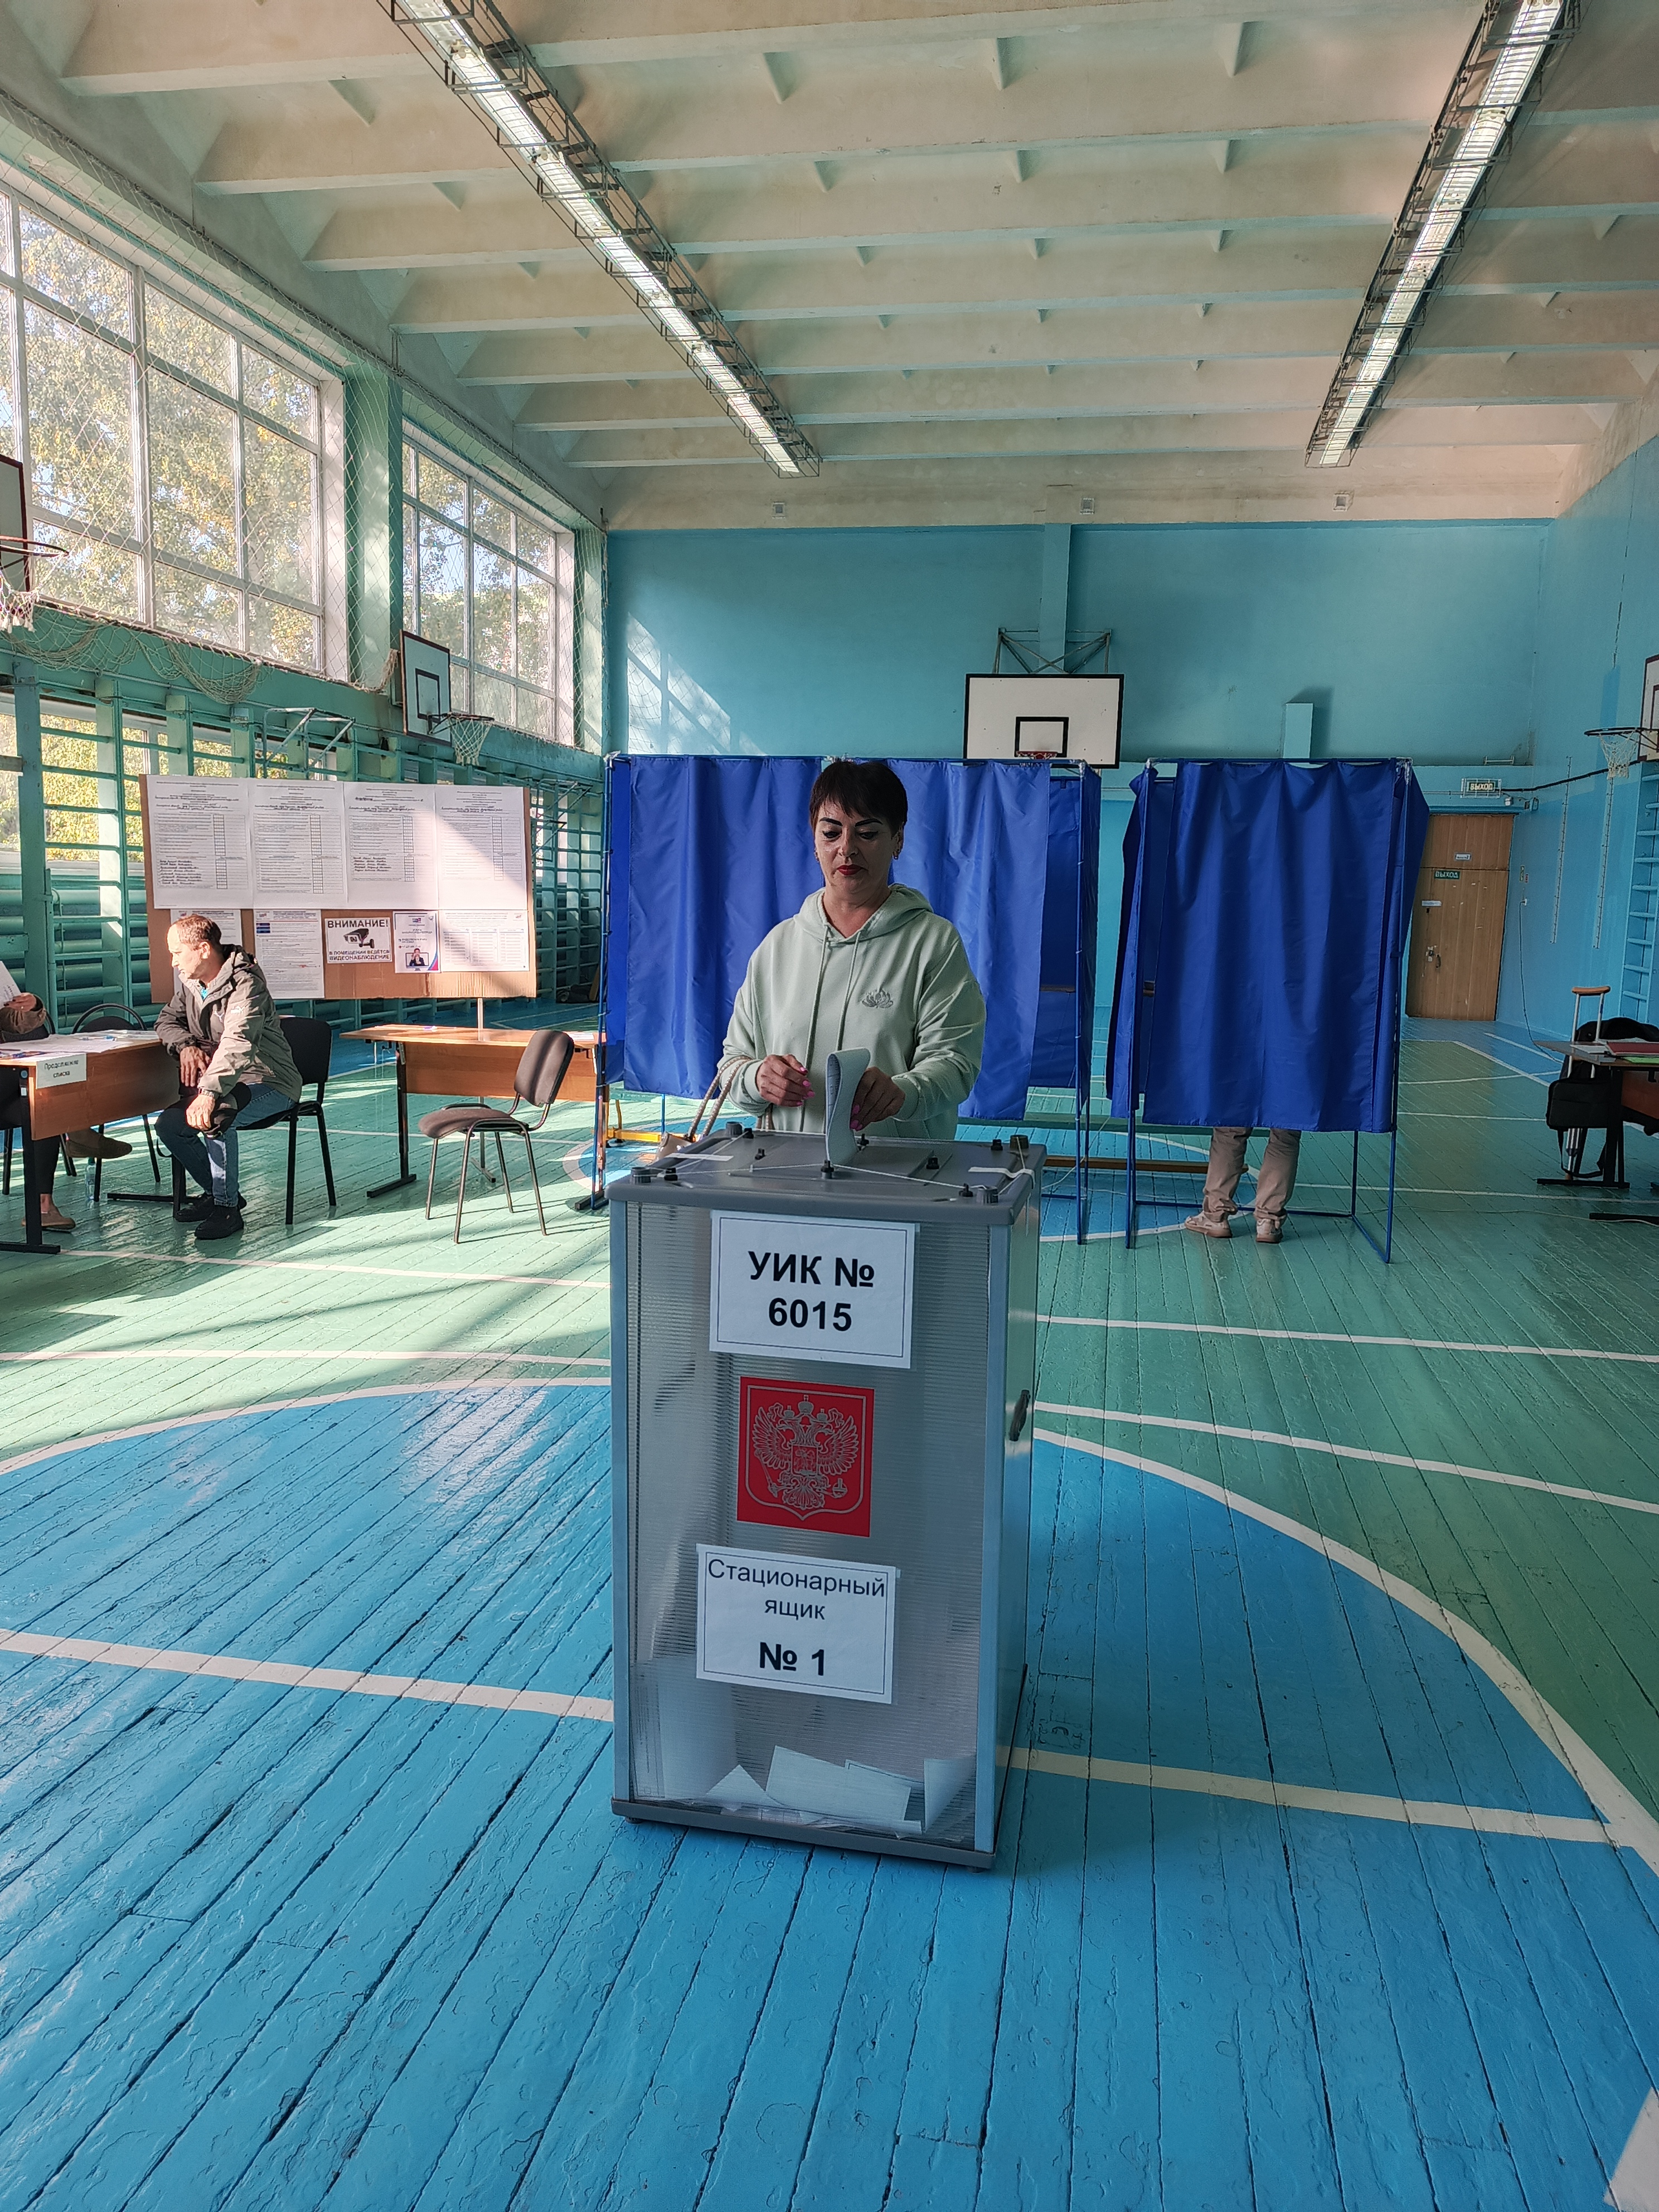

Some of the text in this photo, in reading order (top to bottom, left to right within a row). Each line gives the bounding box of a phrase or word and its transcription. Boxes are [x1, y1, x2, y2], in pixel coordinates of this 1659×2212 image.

[327, 919, 389, 928] ВНИМАНИЕ!
[748, 1250, 875, 1288] УИК №
[769, 1297, 852, 1332] 6015
[708, 1559, 885, 1597] Стационарный
[764, 1599, 826, 1621] ящик
[759, 1642, 825, 1676] № 1
